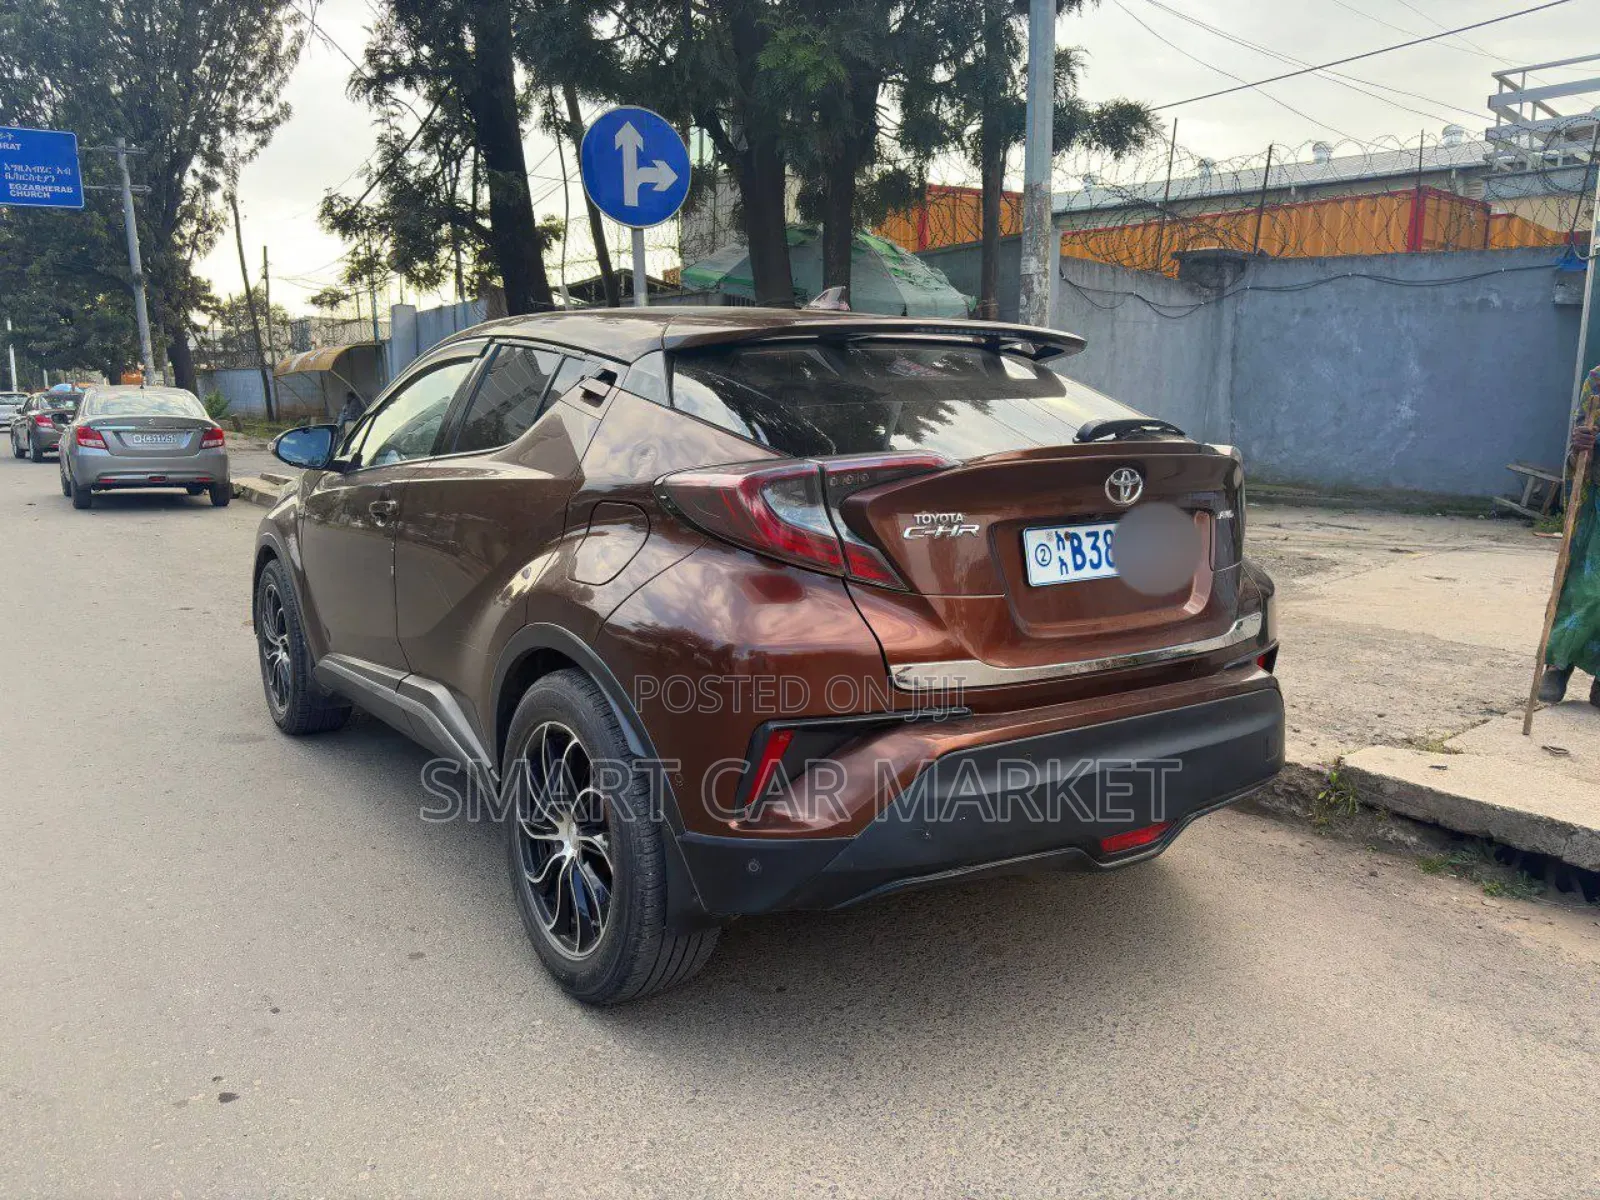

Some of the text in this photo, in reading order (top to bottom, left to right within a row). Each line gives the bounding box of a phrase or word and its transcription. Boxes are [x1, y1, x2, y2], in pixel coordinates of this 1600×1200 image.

[9, 189, 51, 199] CHURCH
[913, 512, 964, 524] TOYOTA
[903, 524, 980, 540] C-HR
